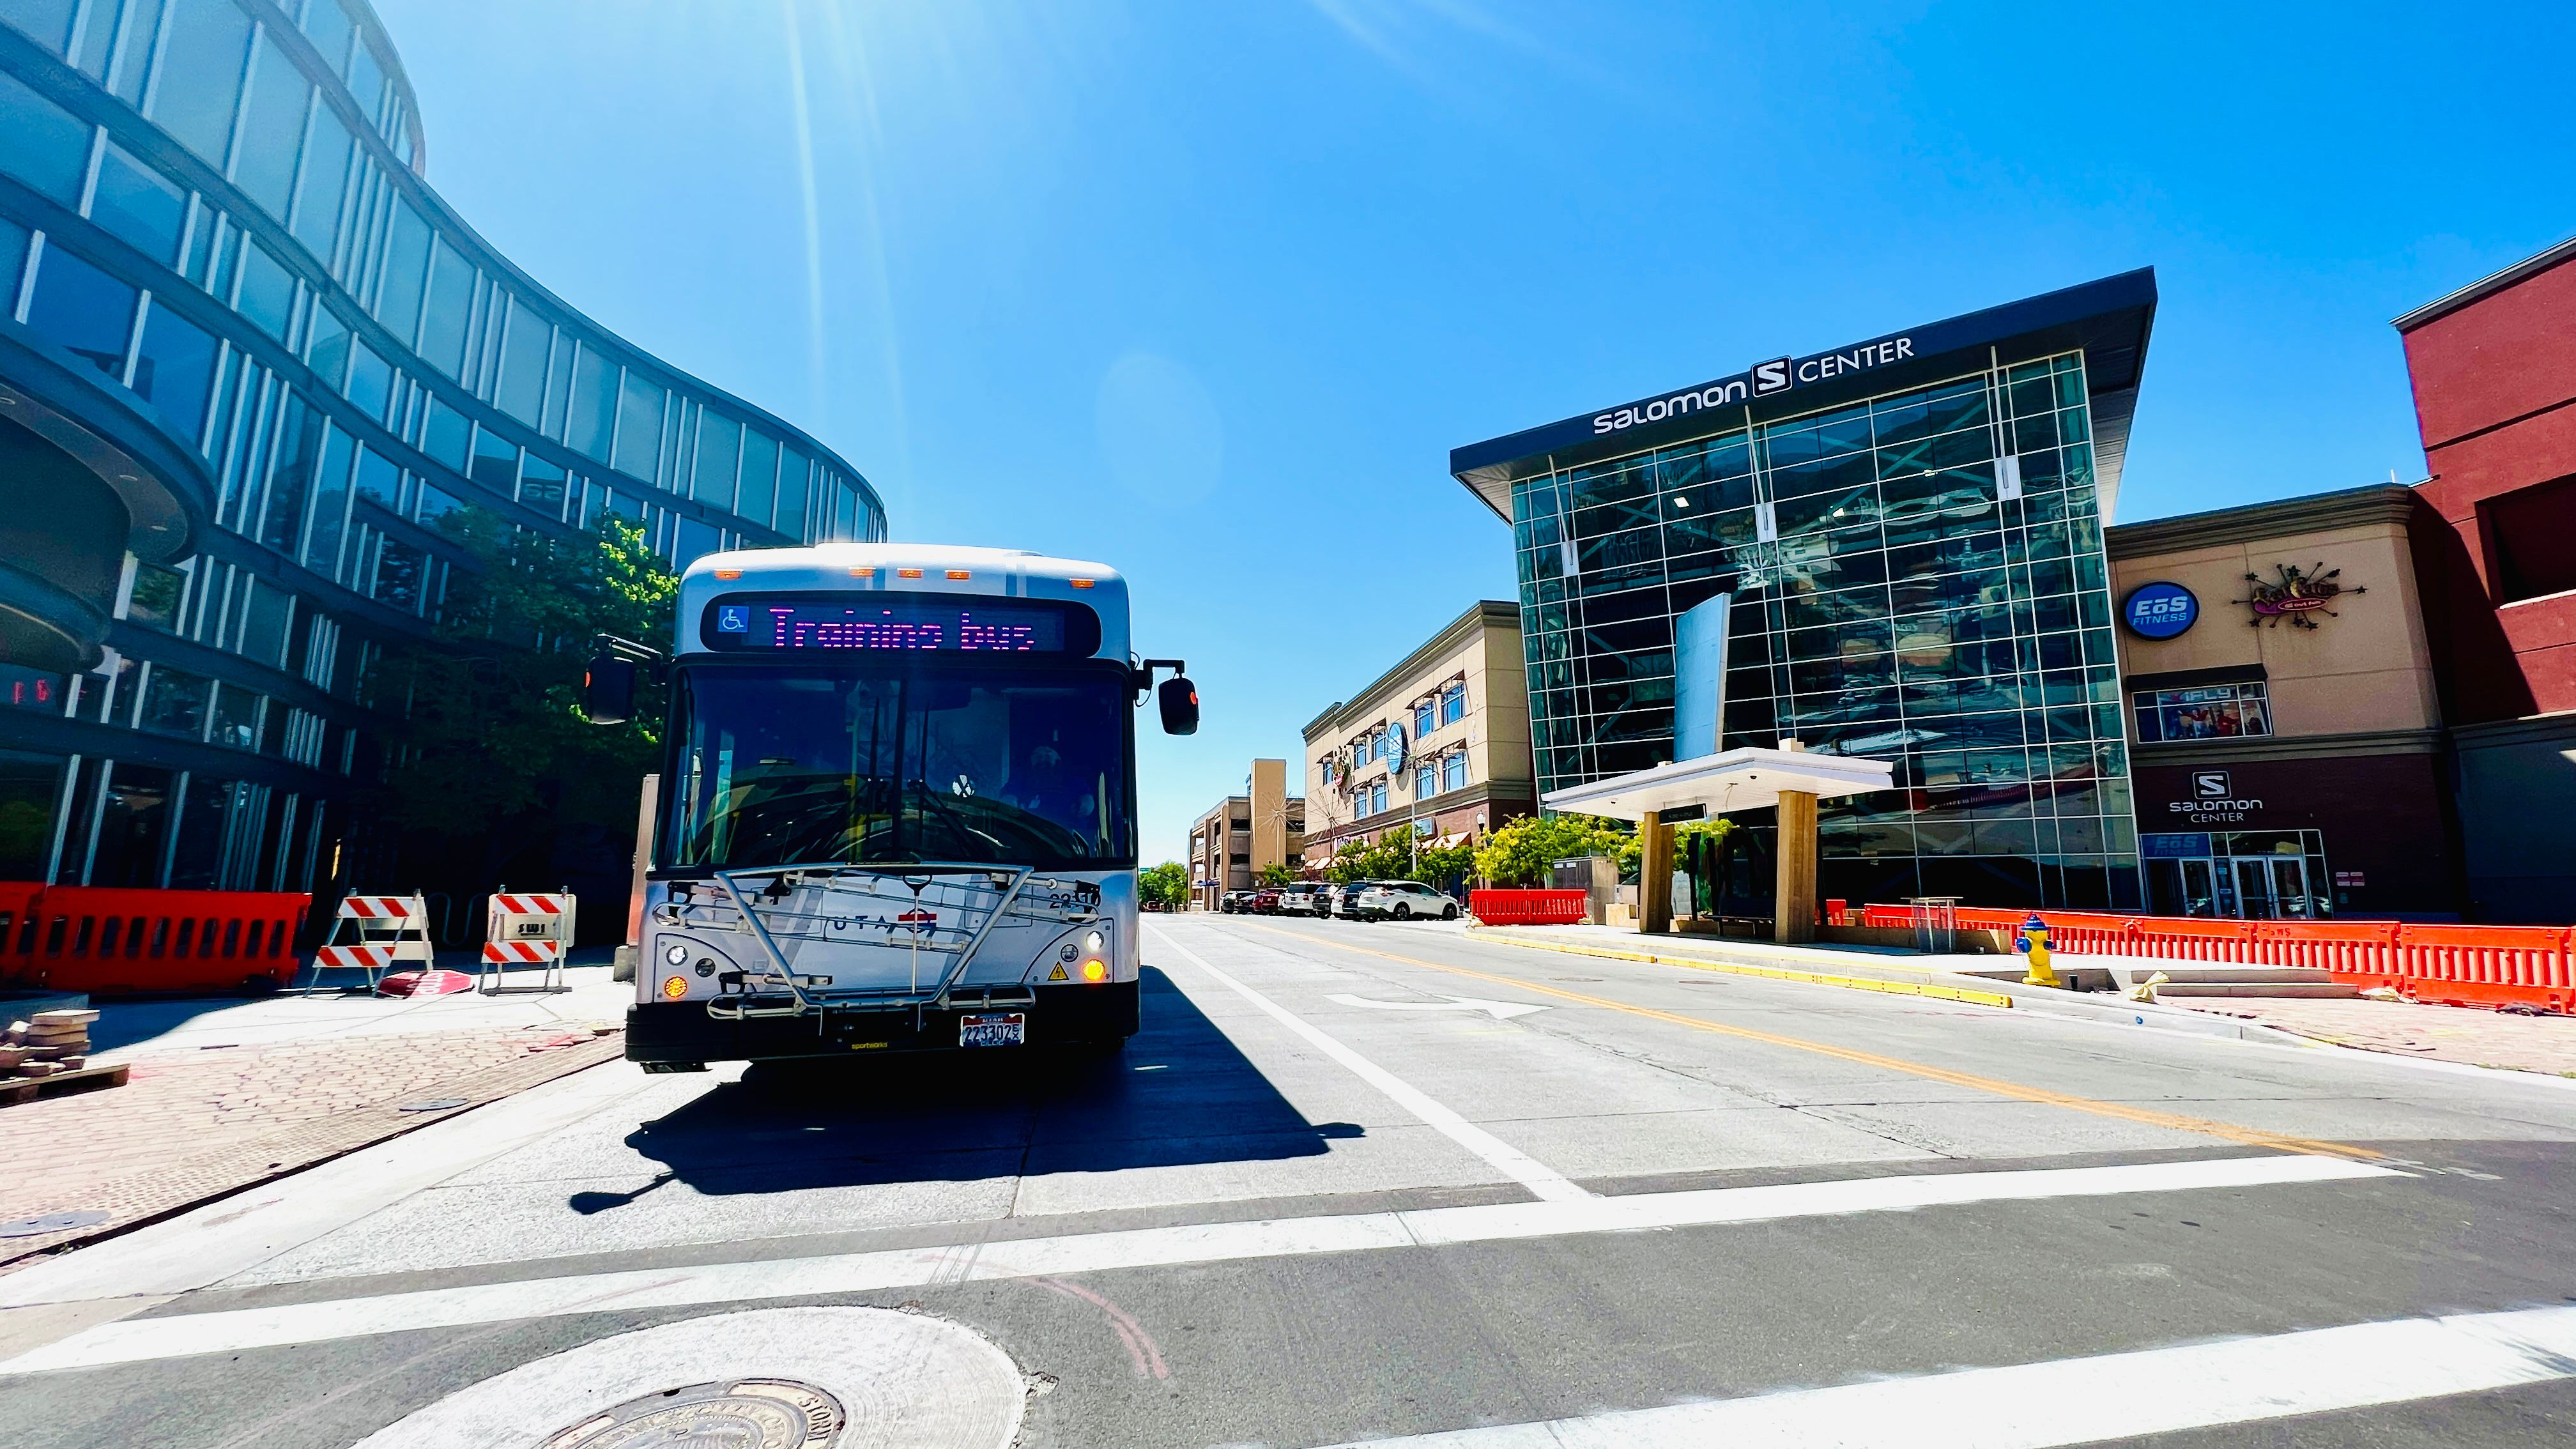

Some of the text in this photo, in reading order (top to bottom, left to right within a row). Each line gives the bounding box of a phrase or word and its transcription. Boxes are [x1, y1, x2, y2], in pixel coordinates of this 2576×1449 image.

[1798, 337, 1915, 383] CENTER
[769, 606, 1035, 650] Training bus
[2133, 612, 2187, 626] FITNESS
[2191, 812, 2244, 823] CENTER
[834, 915, 889, 931] UTA
[406, 972, 446, 995] STOP
[965, 1024, 1012, 1042] 223302
[798, 1395, 832, 1441] STORM
